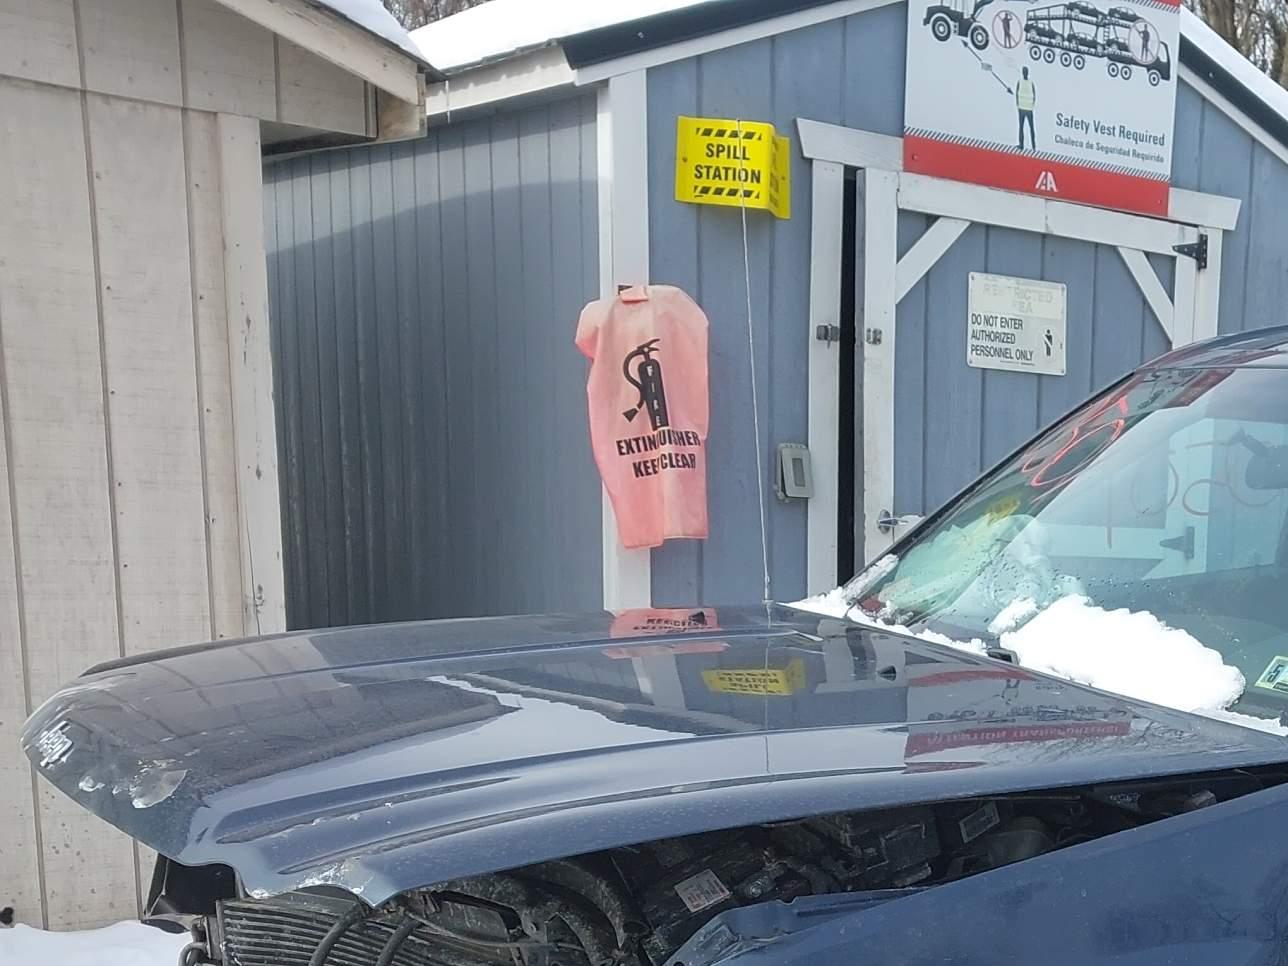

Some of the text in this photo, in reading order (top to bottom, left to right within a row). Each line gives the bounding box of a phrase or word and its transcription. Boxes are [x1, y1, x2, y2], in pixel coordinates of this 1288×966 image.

[1055, 112, 1165, 146] Safety Vest Required
[705, 143, 751, 161] SPILL
[1085, 140, 1095, 150] de
[1095, 142, 1131, 156] Seguridad
[694, 164, 761, 184] STATION
[971, 313, 1024, 330] DO NOT ENTER
[971, 328, 1016, 344] AUTHORIZED
[970, 344, 1034, 361] PERSONNEL ONLY
[646, 365, 662, 427] FIRE
[615, 429, 701, 456] EXTINUISHER
[632, 452, 697, 478] KEE CLEAR
